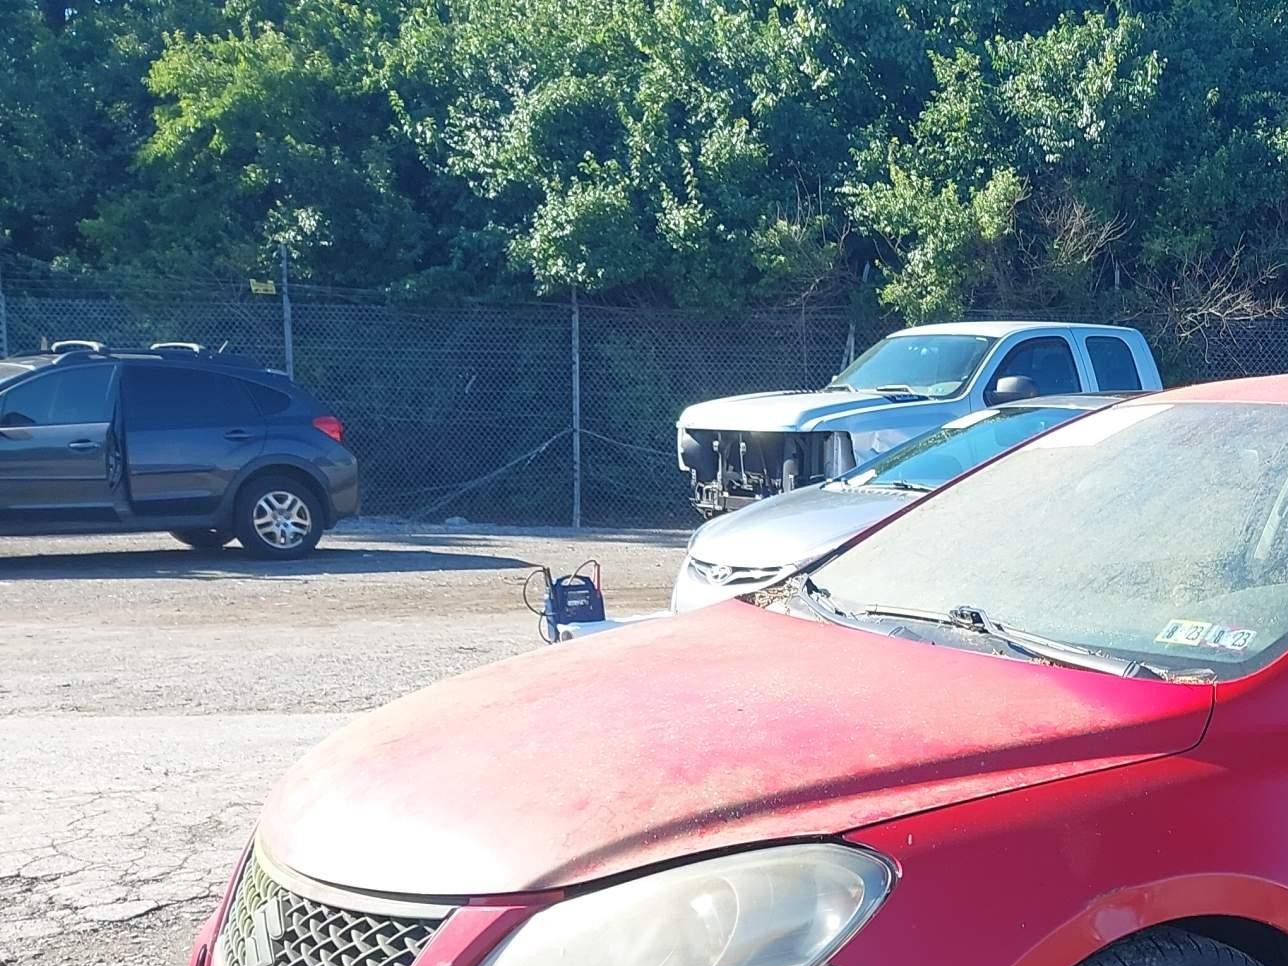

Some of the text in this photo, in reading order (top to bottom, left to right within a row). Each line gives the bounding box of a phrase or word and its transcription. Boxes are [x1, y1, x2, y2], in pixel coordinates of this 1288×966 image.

[1166, 625, 1204, 641] 8 23
[1232, 631, 1252, 647] 23
